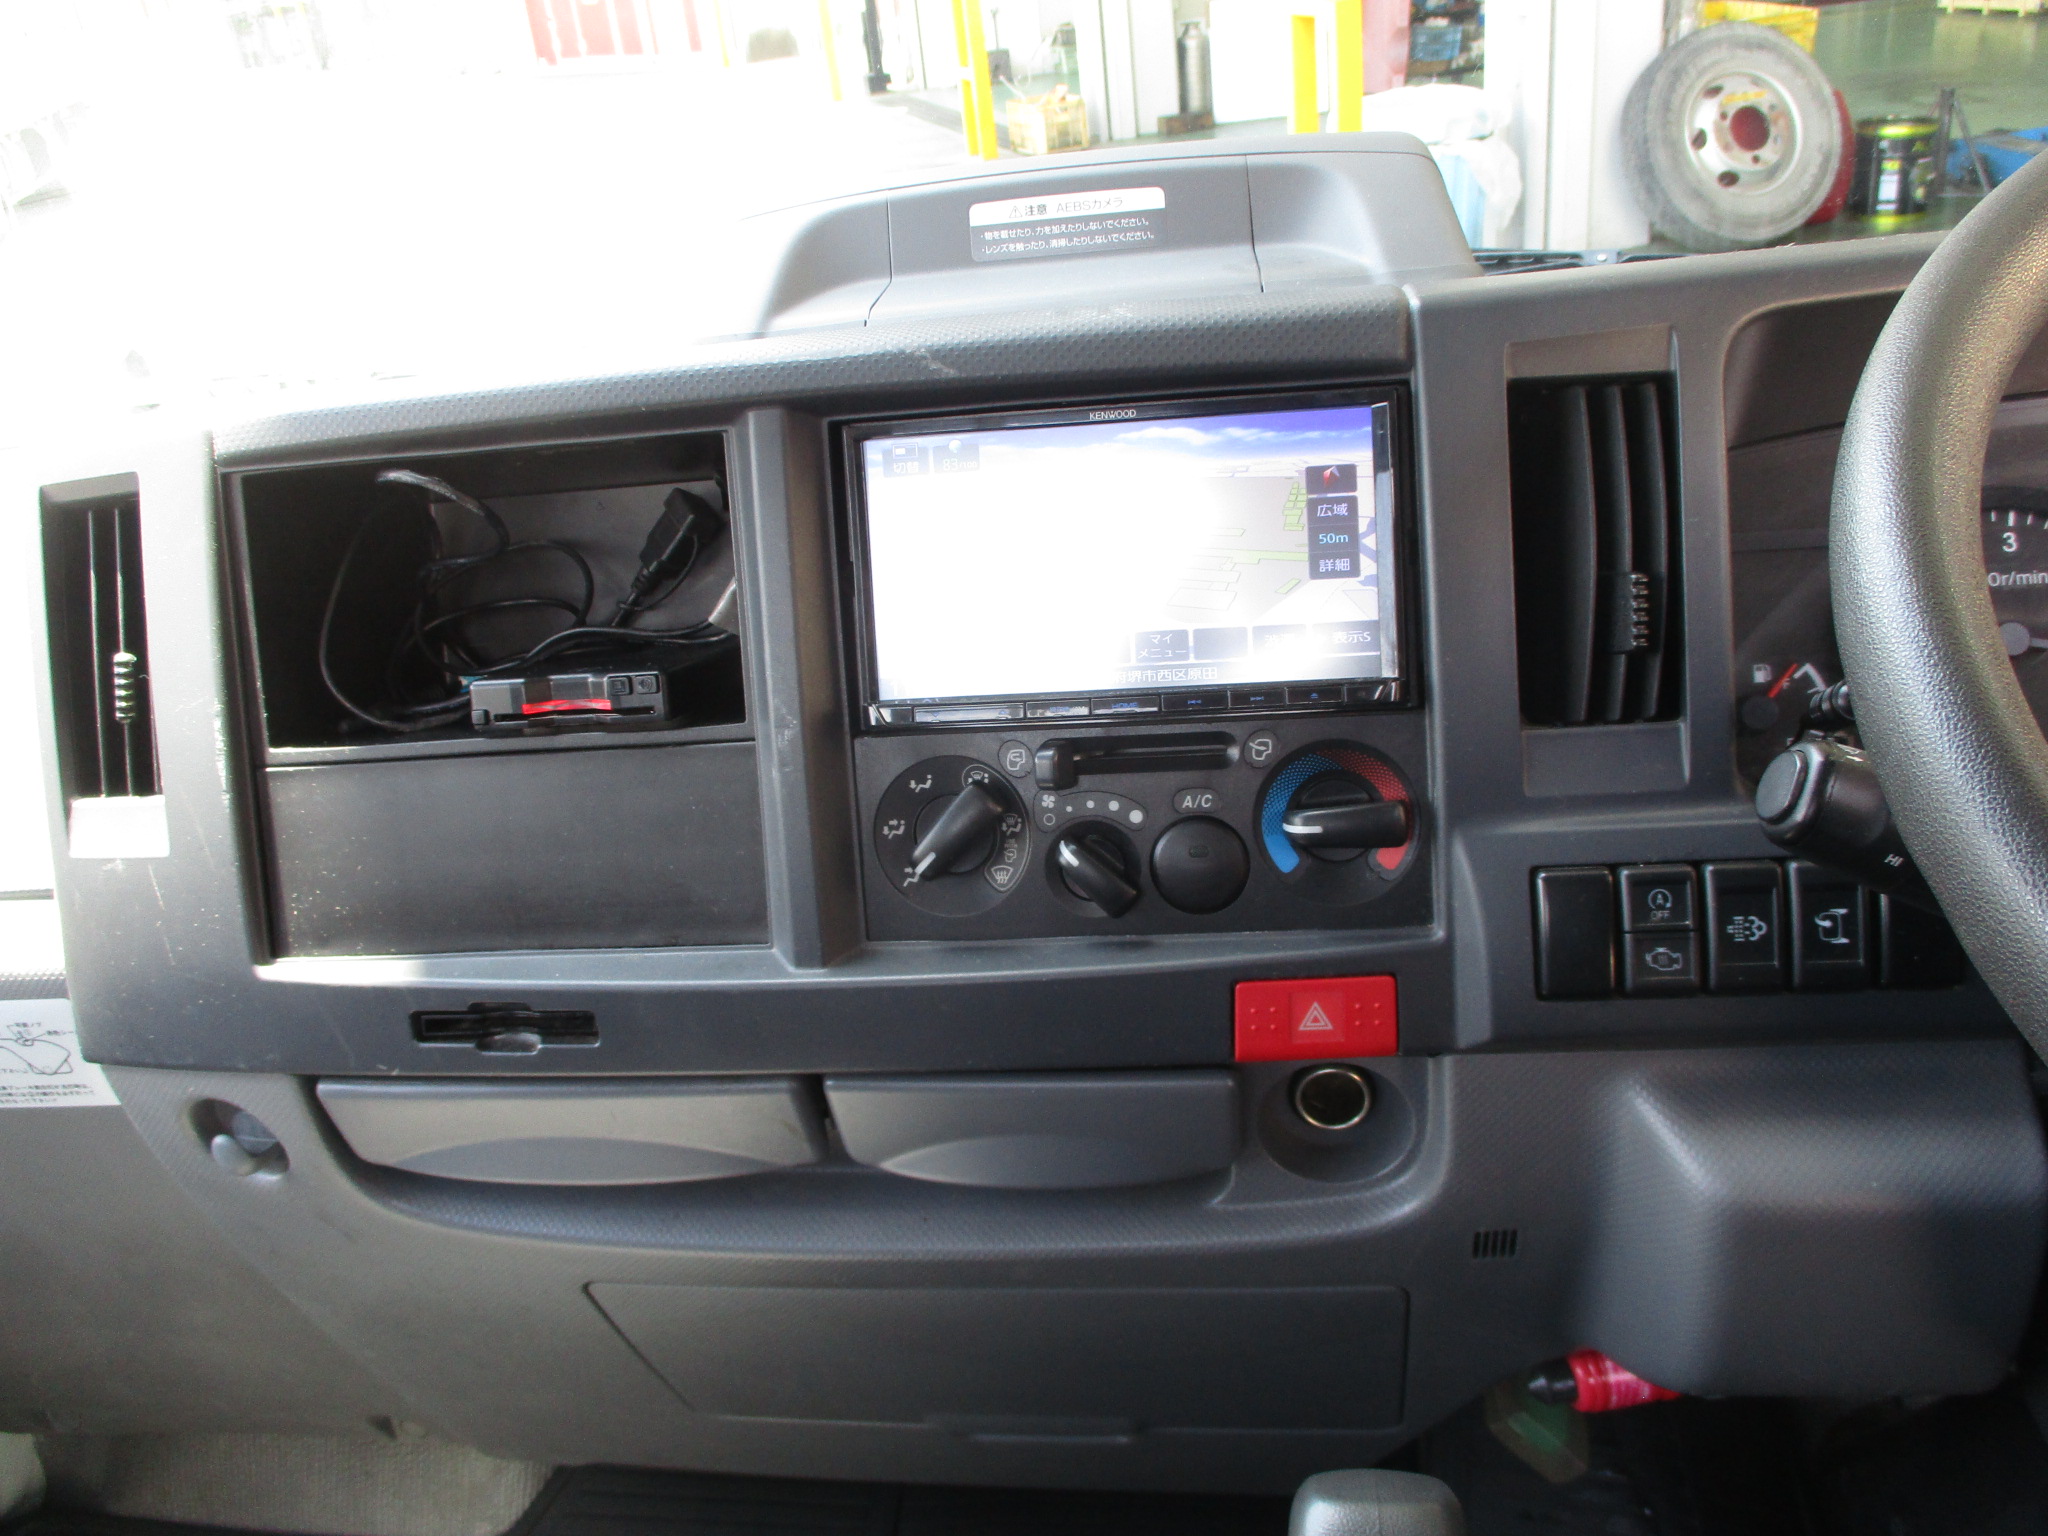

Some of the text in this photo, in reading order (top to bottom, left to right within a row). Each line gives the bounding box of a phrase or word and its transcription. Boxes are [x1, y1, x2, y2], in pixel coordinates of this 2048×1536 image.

[1025, 197, 1124, 217] 注意 AEBSカメラ
[1089, 409, 1137, 421] KENWOOD
[893, 461, 919, 475] 切替
[1317, 502, 1349, 518] 広域
[1318, 533, 1349, 545] 50m
[2002, 531, 2018, 553] 3
[1319, 557, 1351, 573] 詳細
[1149, 633, 1173, 645] マイ
[1137, 648, 1187, 660] メニュー
[1111, 701, 1139, 710] HOME
[1182, 794, 1213, 809] A/C
[1650, 910, 1671, 921] OFF
